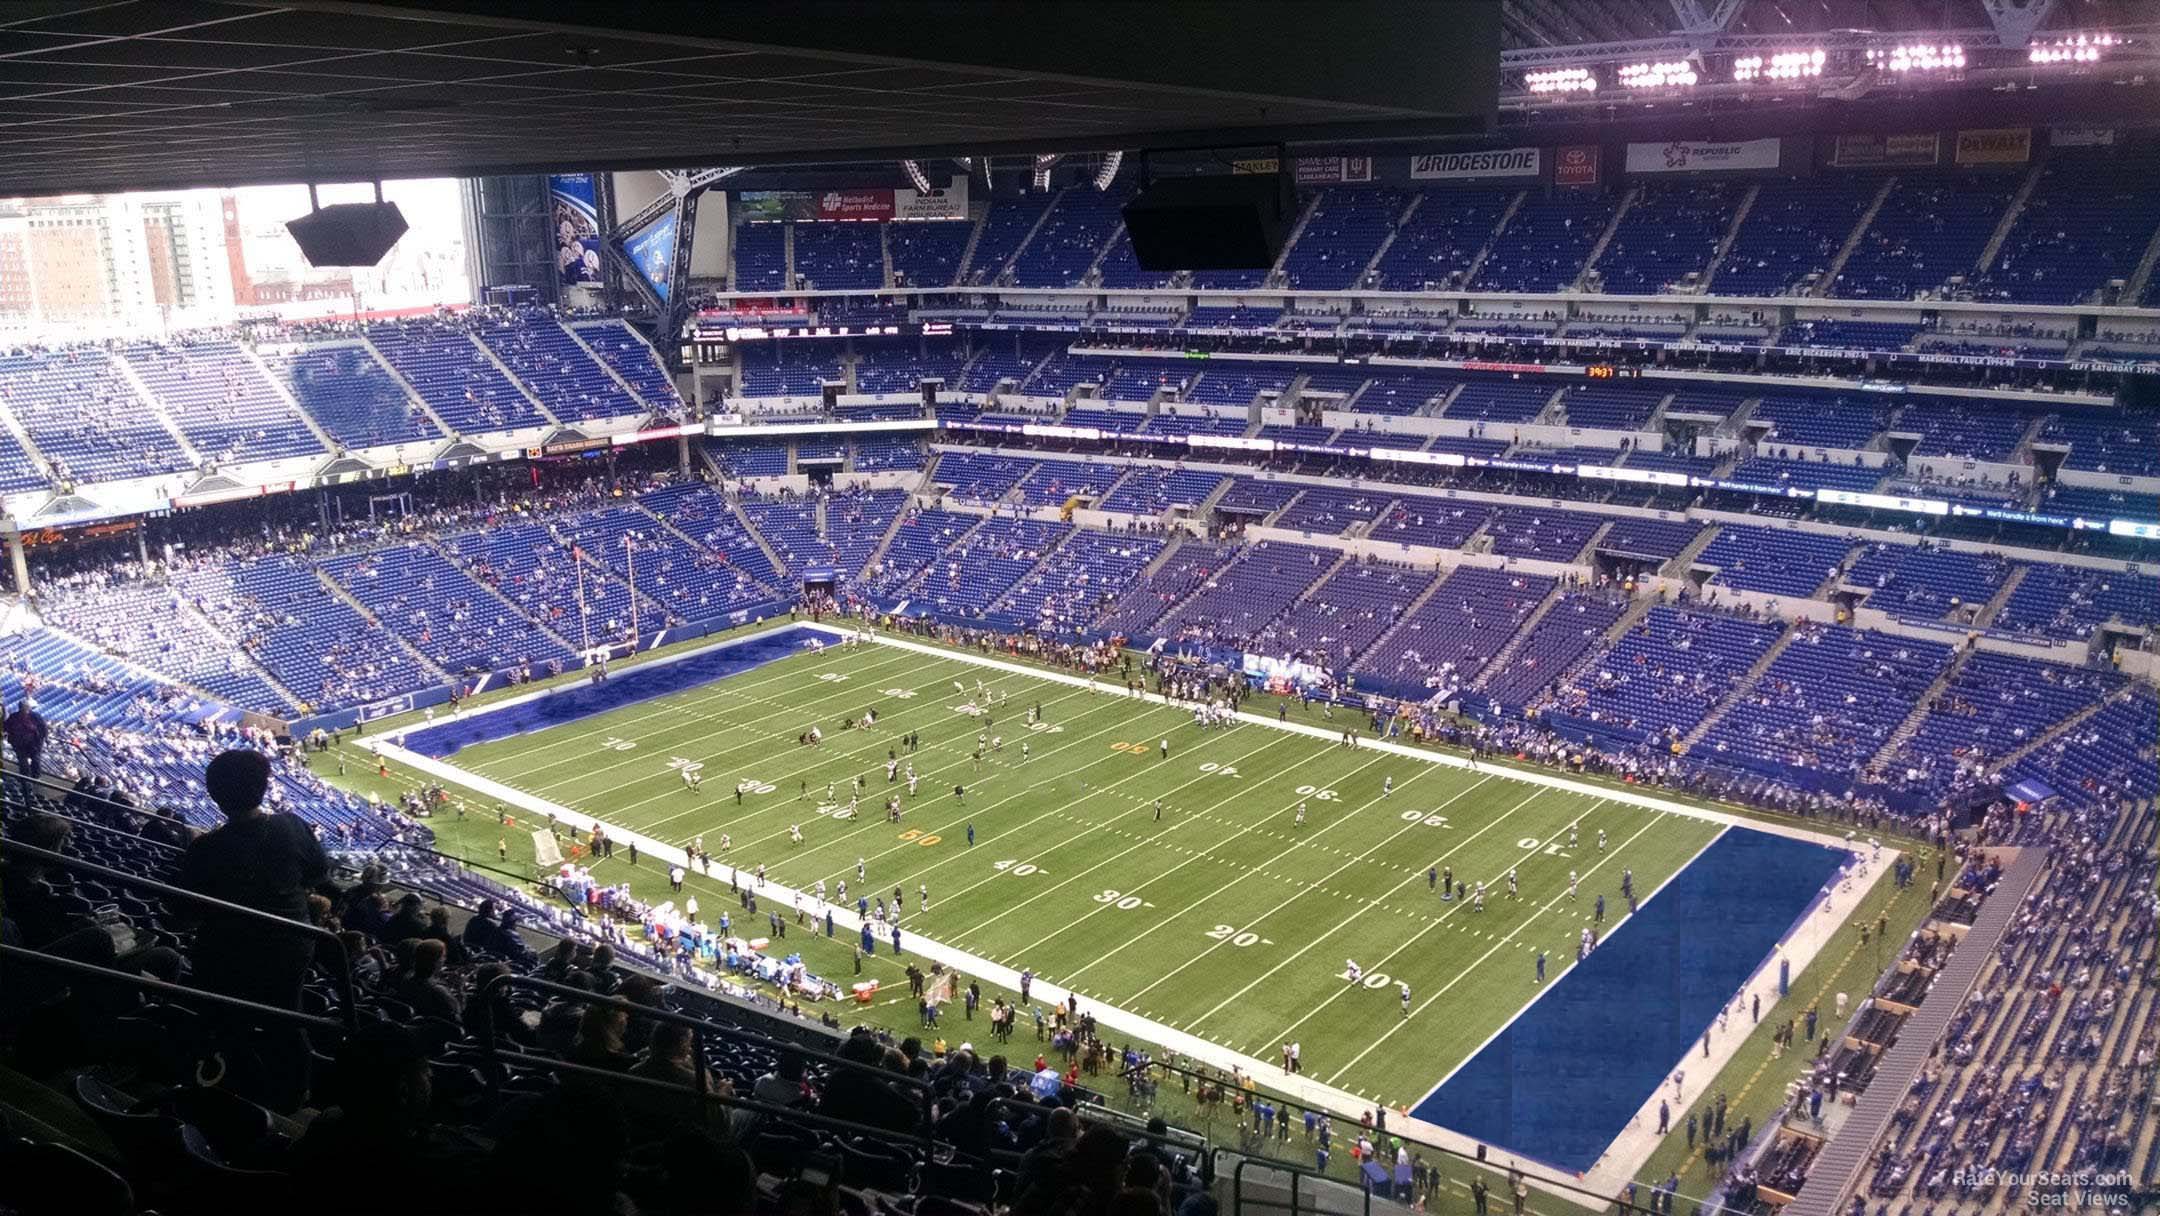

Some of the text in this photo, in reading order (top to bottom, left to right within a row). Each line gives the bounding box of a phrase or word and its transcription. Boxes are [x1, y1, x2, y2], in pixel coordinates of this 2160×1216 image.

[1416, 152, 1535, 173] BRIDGESTONE
[1557, 165, 1595, 175] TOYOTA
[1918, 355, 1958, 364] MARSHALL
[1959, 357, 1984, 365] FAULK
[2070, 363, 2089, 371] JEFF
[2091, 364, 2134, 373] SATURDAY
[1986, 510, 2004, 518] We'll
[2004, 512, 2025, 520] handle
[2030, 514, 2047, 523] from
[898, 829, 942, 847] 50
[1517, 838, 1565, 856] 10
[993, 859, 1038, 877] 40
[1093, 889, 1142, 910] 30
[1205, 924, 1259, 947] 20
